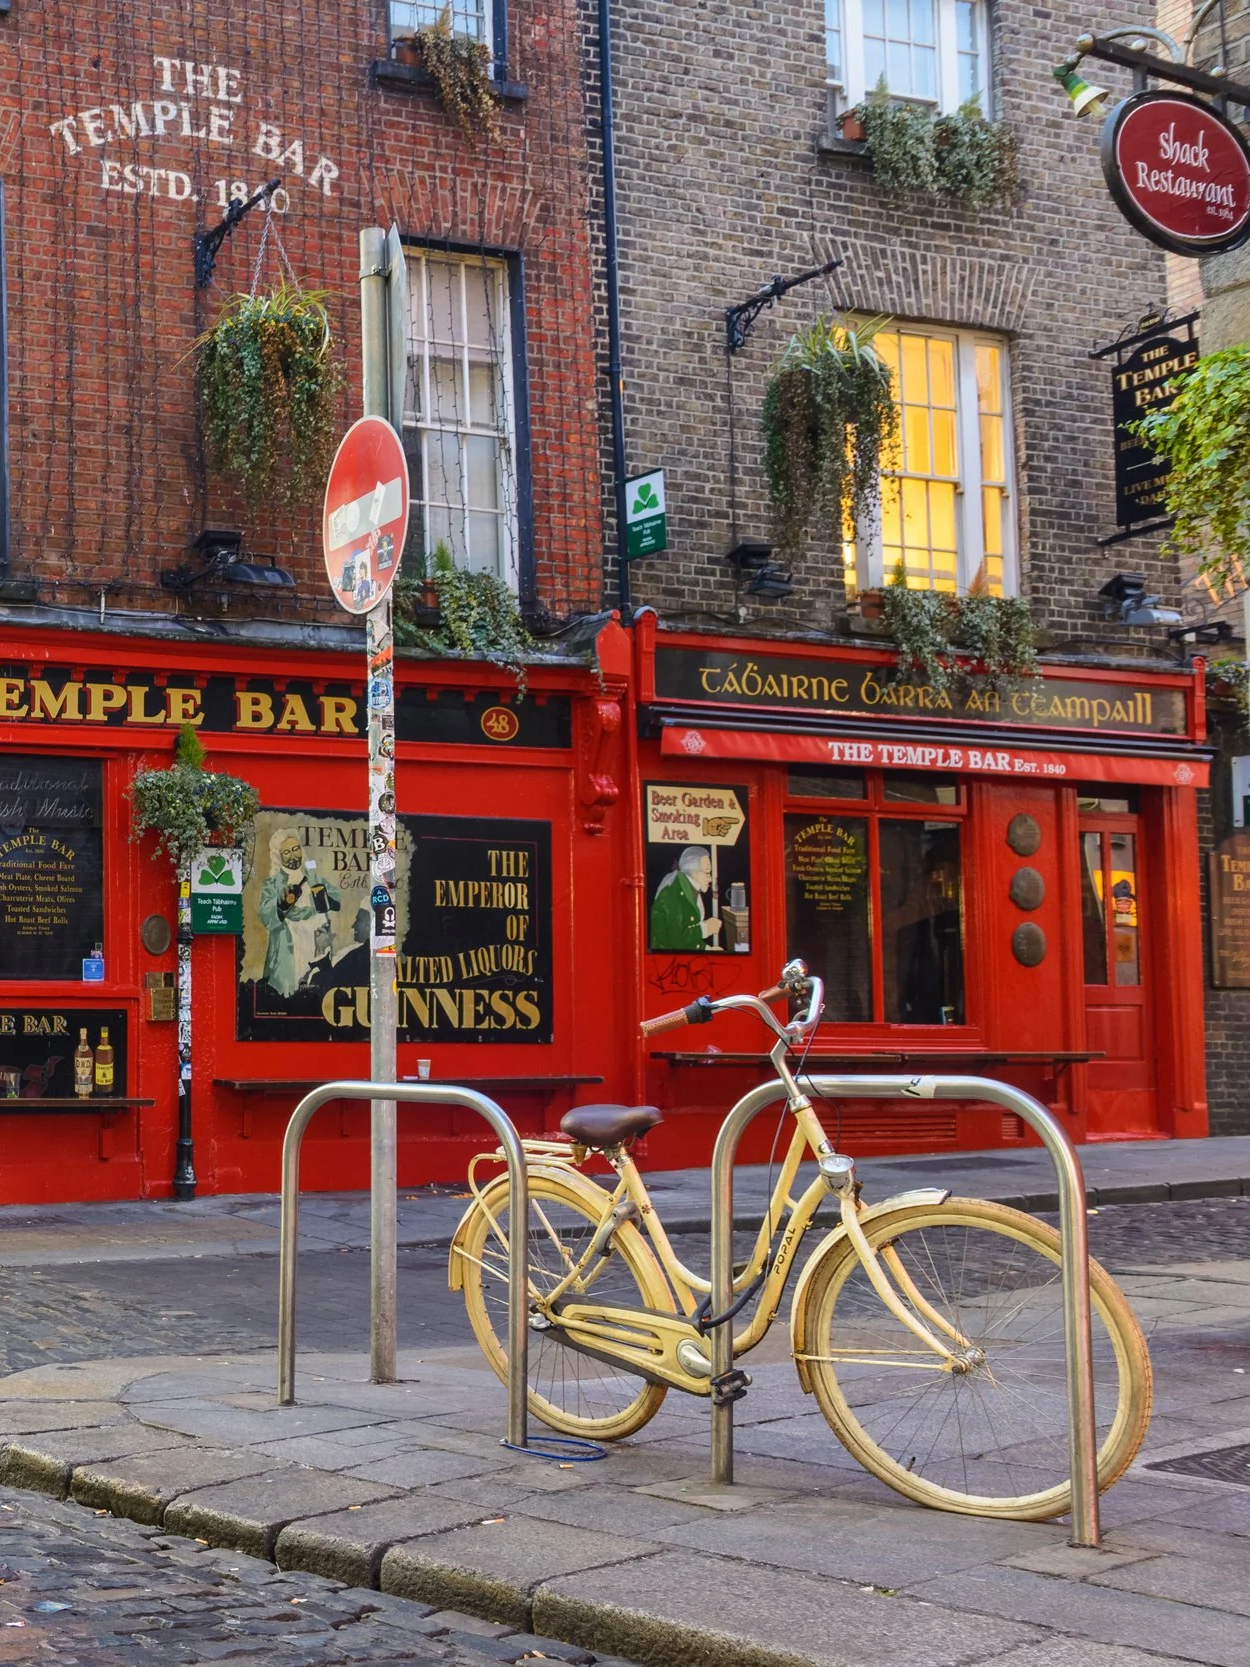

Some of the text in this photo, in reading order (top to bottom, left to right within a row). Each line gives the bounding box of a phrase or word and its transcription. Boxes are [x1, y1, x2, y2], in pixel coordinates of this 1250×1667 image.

[154, 56, 243, 103] THE
[50, 100, 339, 197] TEMPLE BAR
[101, 159, 199, 202] ESTD.
[1135, 161, 1237, 208] Restaurant
[1141, 345, 1169, 362] THE
[1116, 351, 1197, 392] TEMPLE
[1134, 385, 1179, 407] BAR
[234, 690, 359, 735] BAR
[486, 711, 513, 736] 48
[828, 740, 874, 763] THE
[878, 744, 963, 769] TEMPLE
[968, 750, 1012, 772] BAR
[1042, 763, 1067, 775] 1840
[36, 797, 95, 819] Music
[651, 790, 679, 807] Beer
[681, 791, 726, 810] Garden
[651, 807, 701, 828] Smoking
[661, 825, 690, 841] Area
[794, 823, 855, 847] TEMPLE BAR
[51, 839, 76, 862] BAR
[38, 860, 57, 870] Food
[59, 861, 76, 870] Fare
[488, 849, 529, 878] THE
[34, 873, 55, 882] Cheese
[57, 874, 76, 882] Board
[34, 884, 59, 893] Smoked
[60, 885, 84, 894] Salmon
[372, 895, 390, 904] RCD
[434, 879, 530, 910] EMPEROR
[7, 904, 67, 914] Toasted Sandwiches
[197, 897, 212, 905] Teach
[212, 905, 223, 913] Pub
[5, 915, 69, 925] Hot Roast Beef Rolls
[506, 914, 530, 942] OF
[395, 943, 538, 985] ALTED LIQUORS
[23, 1015, 71, 1036] BAR
[773, 1227, 797, 1275] POPAL
